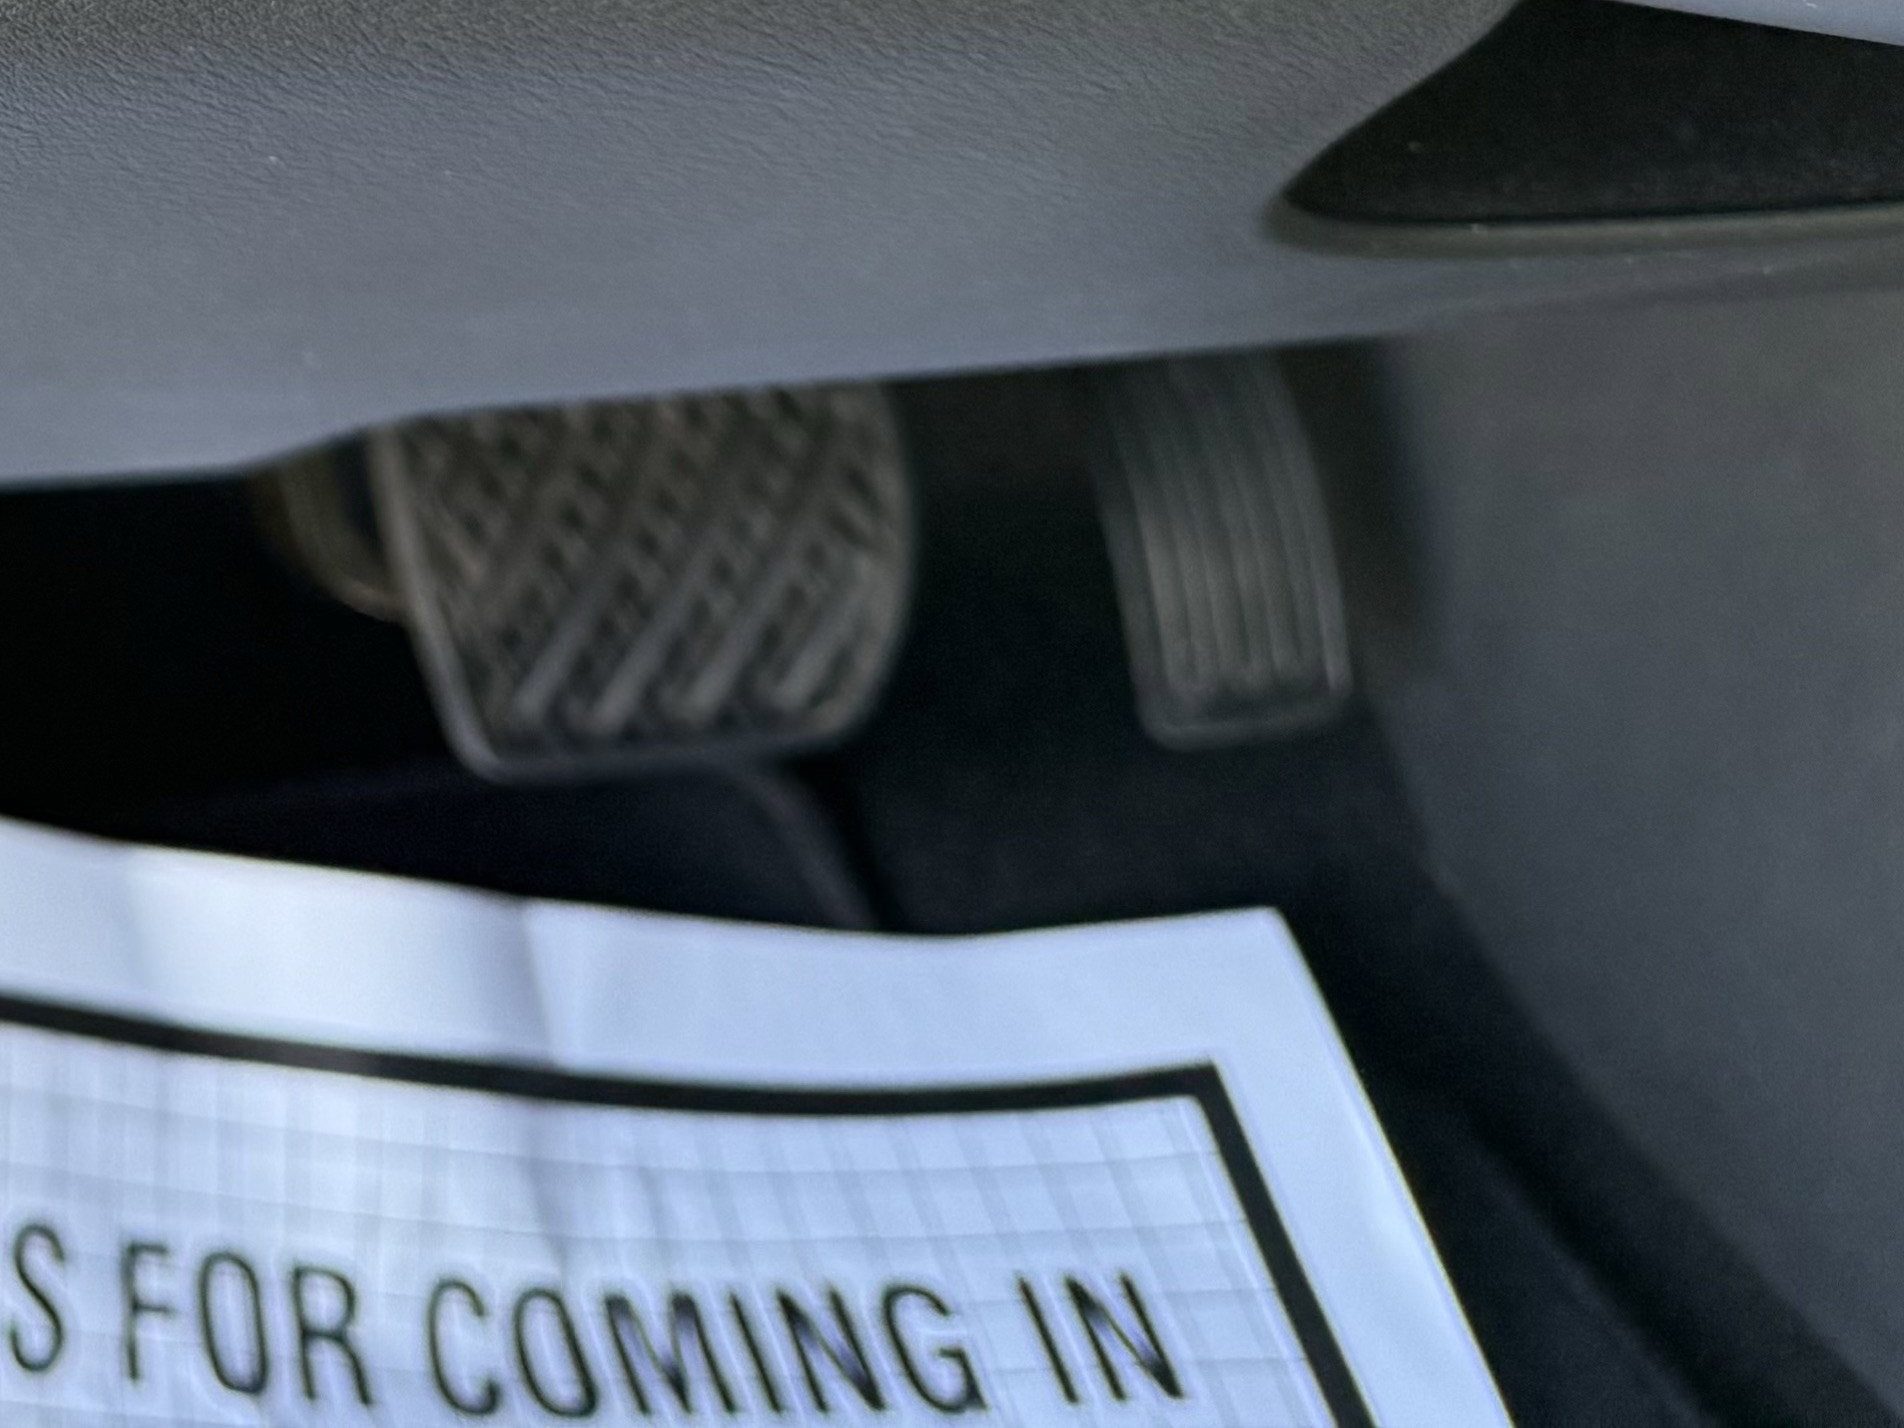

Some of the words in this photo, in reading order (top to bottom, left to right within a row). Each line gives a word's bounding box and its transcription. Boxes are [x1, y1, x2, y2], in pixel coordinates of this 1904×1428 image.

[119, 1229, 376, 1409] FOR
[424, 1274, 990, 1419] COMING
[1014, 1252, 1186, 1406] IN
